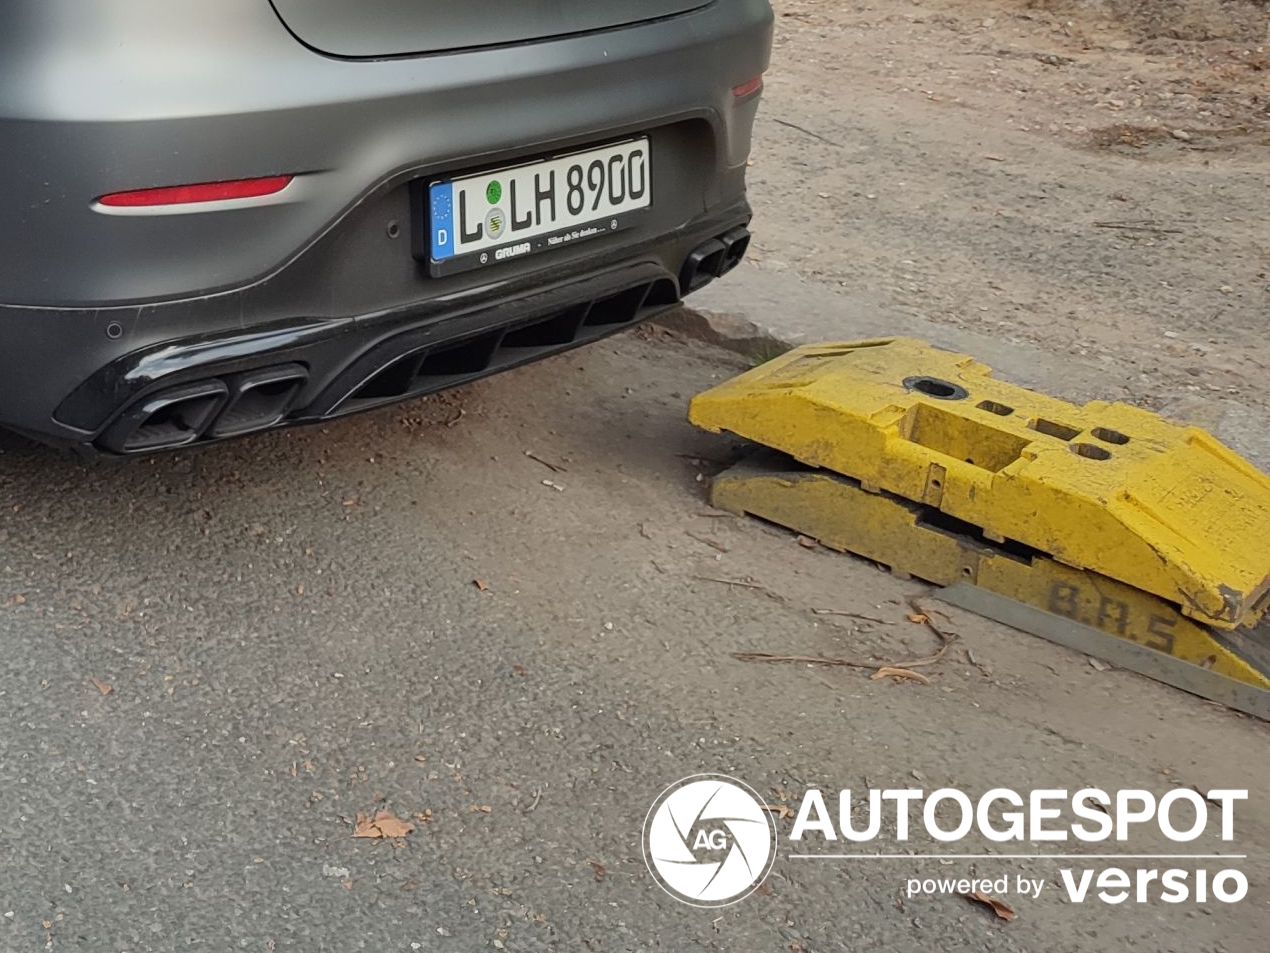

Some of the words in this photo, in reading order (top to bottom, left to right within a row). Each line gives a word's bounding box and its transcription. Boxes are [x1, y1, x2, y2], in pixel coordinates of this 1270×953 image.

[460, 189, 483, 244] L
[510, 170, 556, 231] LH
[567, 149, 645, 216] 8900
[438, 229, 448, 246] D
